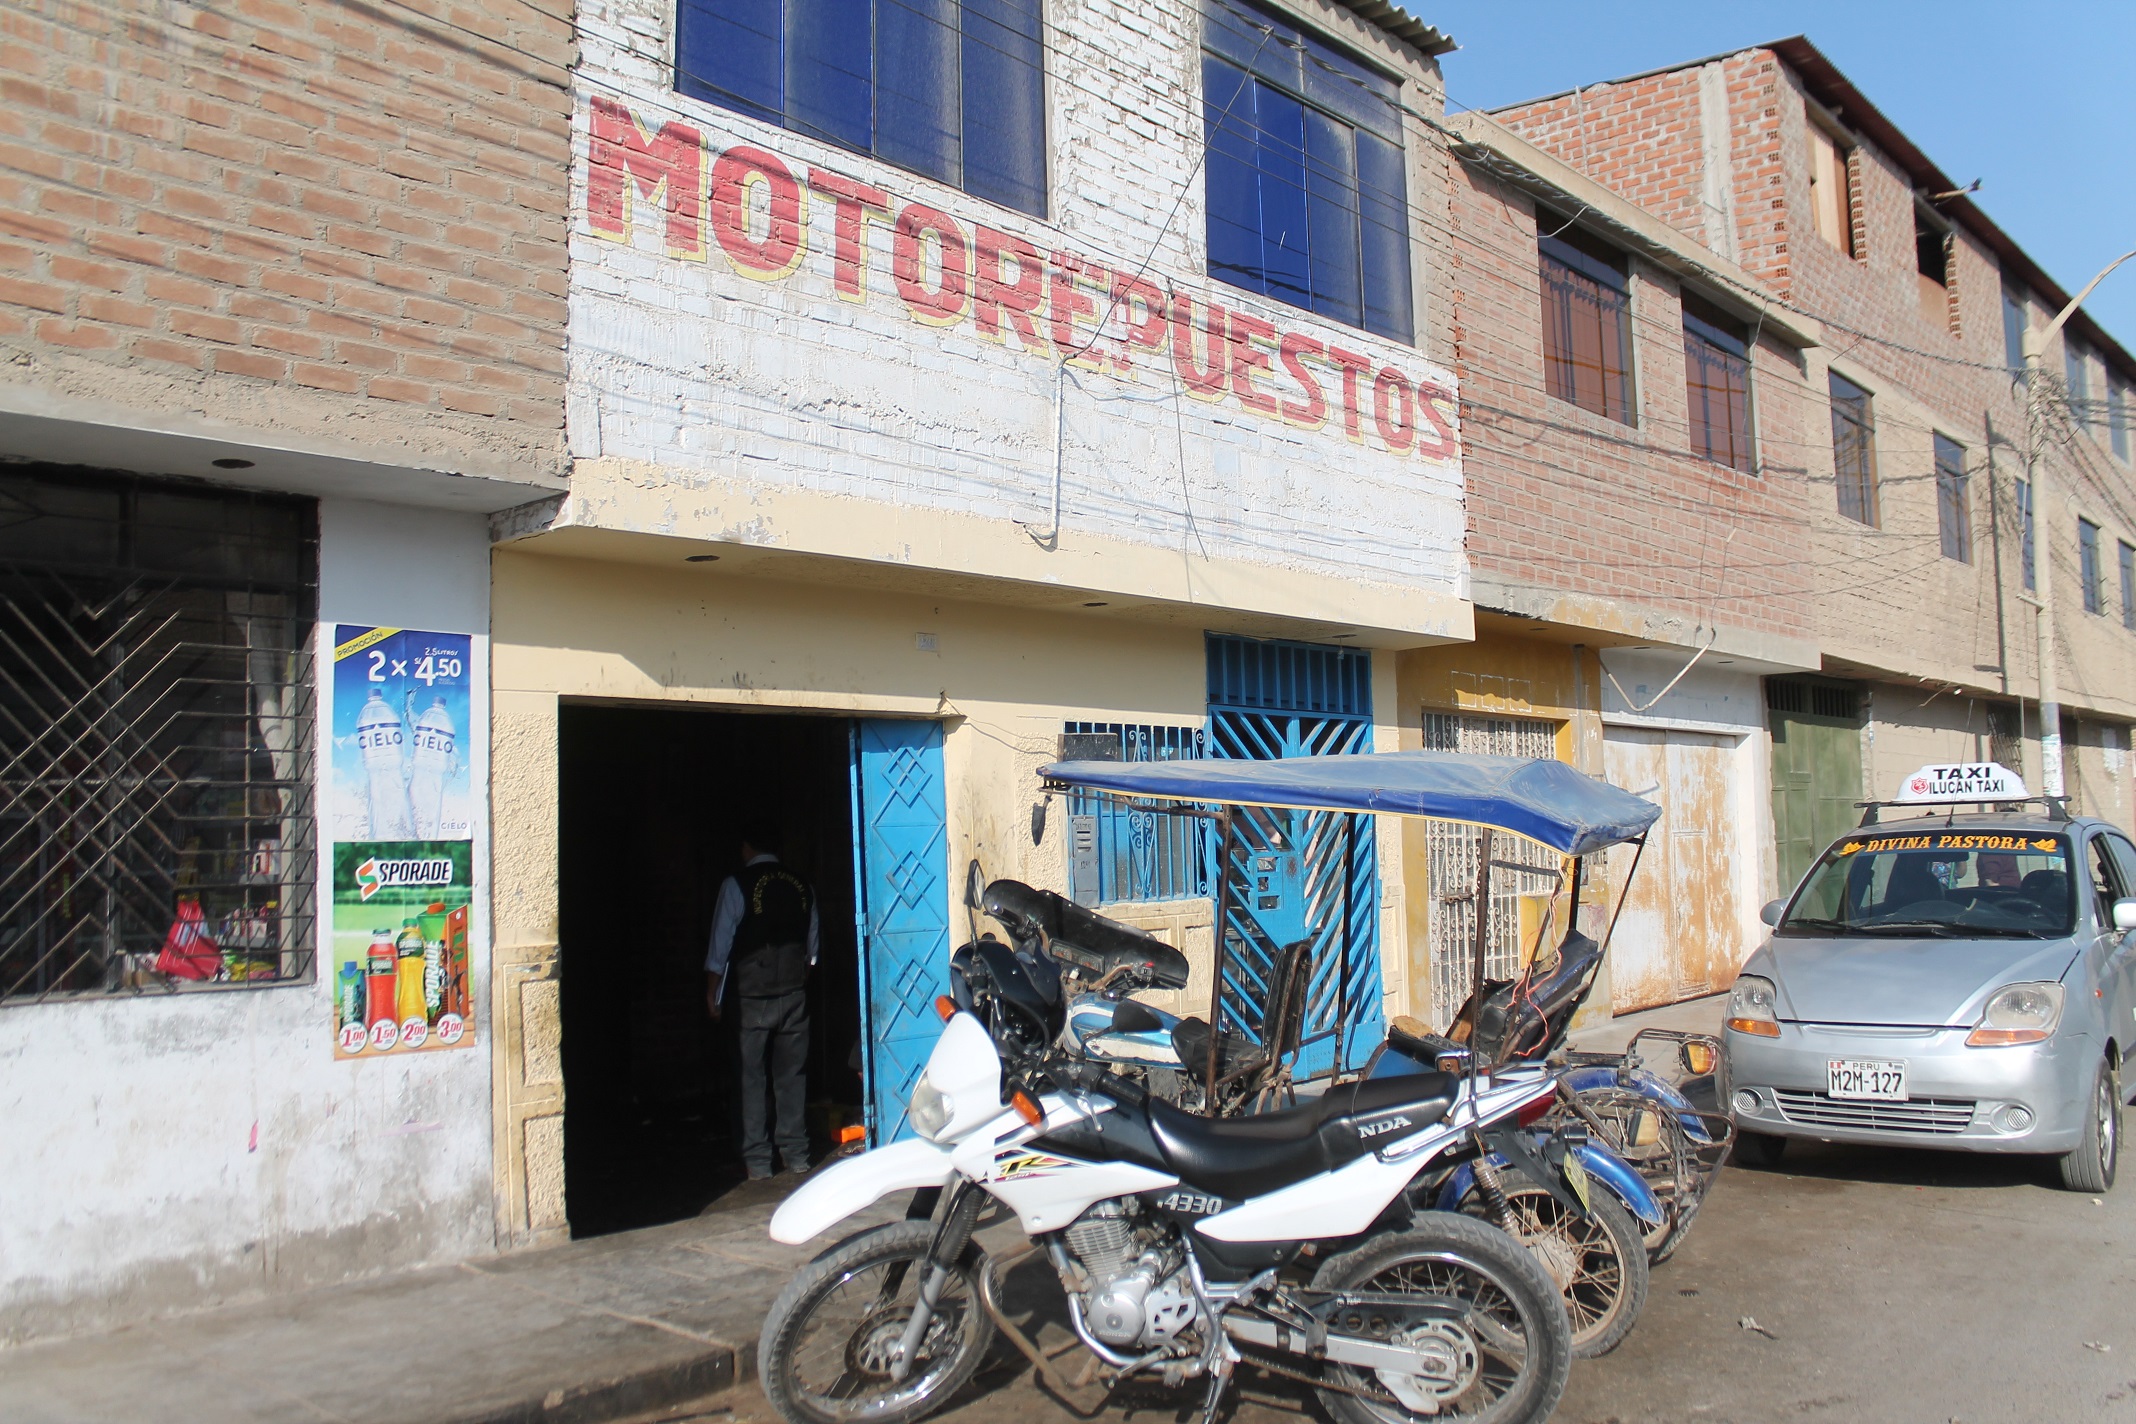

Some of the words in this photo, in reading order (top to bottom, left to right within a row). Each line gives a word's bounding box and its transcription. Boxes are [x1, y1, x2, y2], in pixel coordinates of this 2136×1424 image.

[587, 95, 1460, 464] MOTOREPUESTOS
[336, 631, 383, 657] PROMOCIÓN
[368, 650, 386, 682] 2
[415, 656, 462, 687] 4.50
[359, 731, 402, 749] CIELO
[413, 734, 453, 753] CIELO
[1932, 766, 1991, 780] TAXI
[1928, 780, 1972, 795] ILUCAN
[1977, 779, 2004, 793] TAXI
[441, 822, 467, 830] CIELO
[1865, 836, 1931, 853] DIVINA
[1937, 835, 2027, 850] PASTORA
[379, 860, 450, 883] SPORADE
[1852, 1062, 1880, 1071] PERU
[1831, 1069, 1902, 1093] M2M-127
